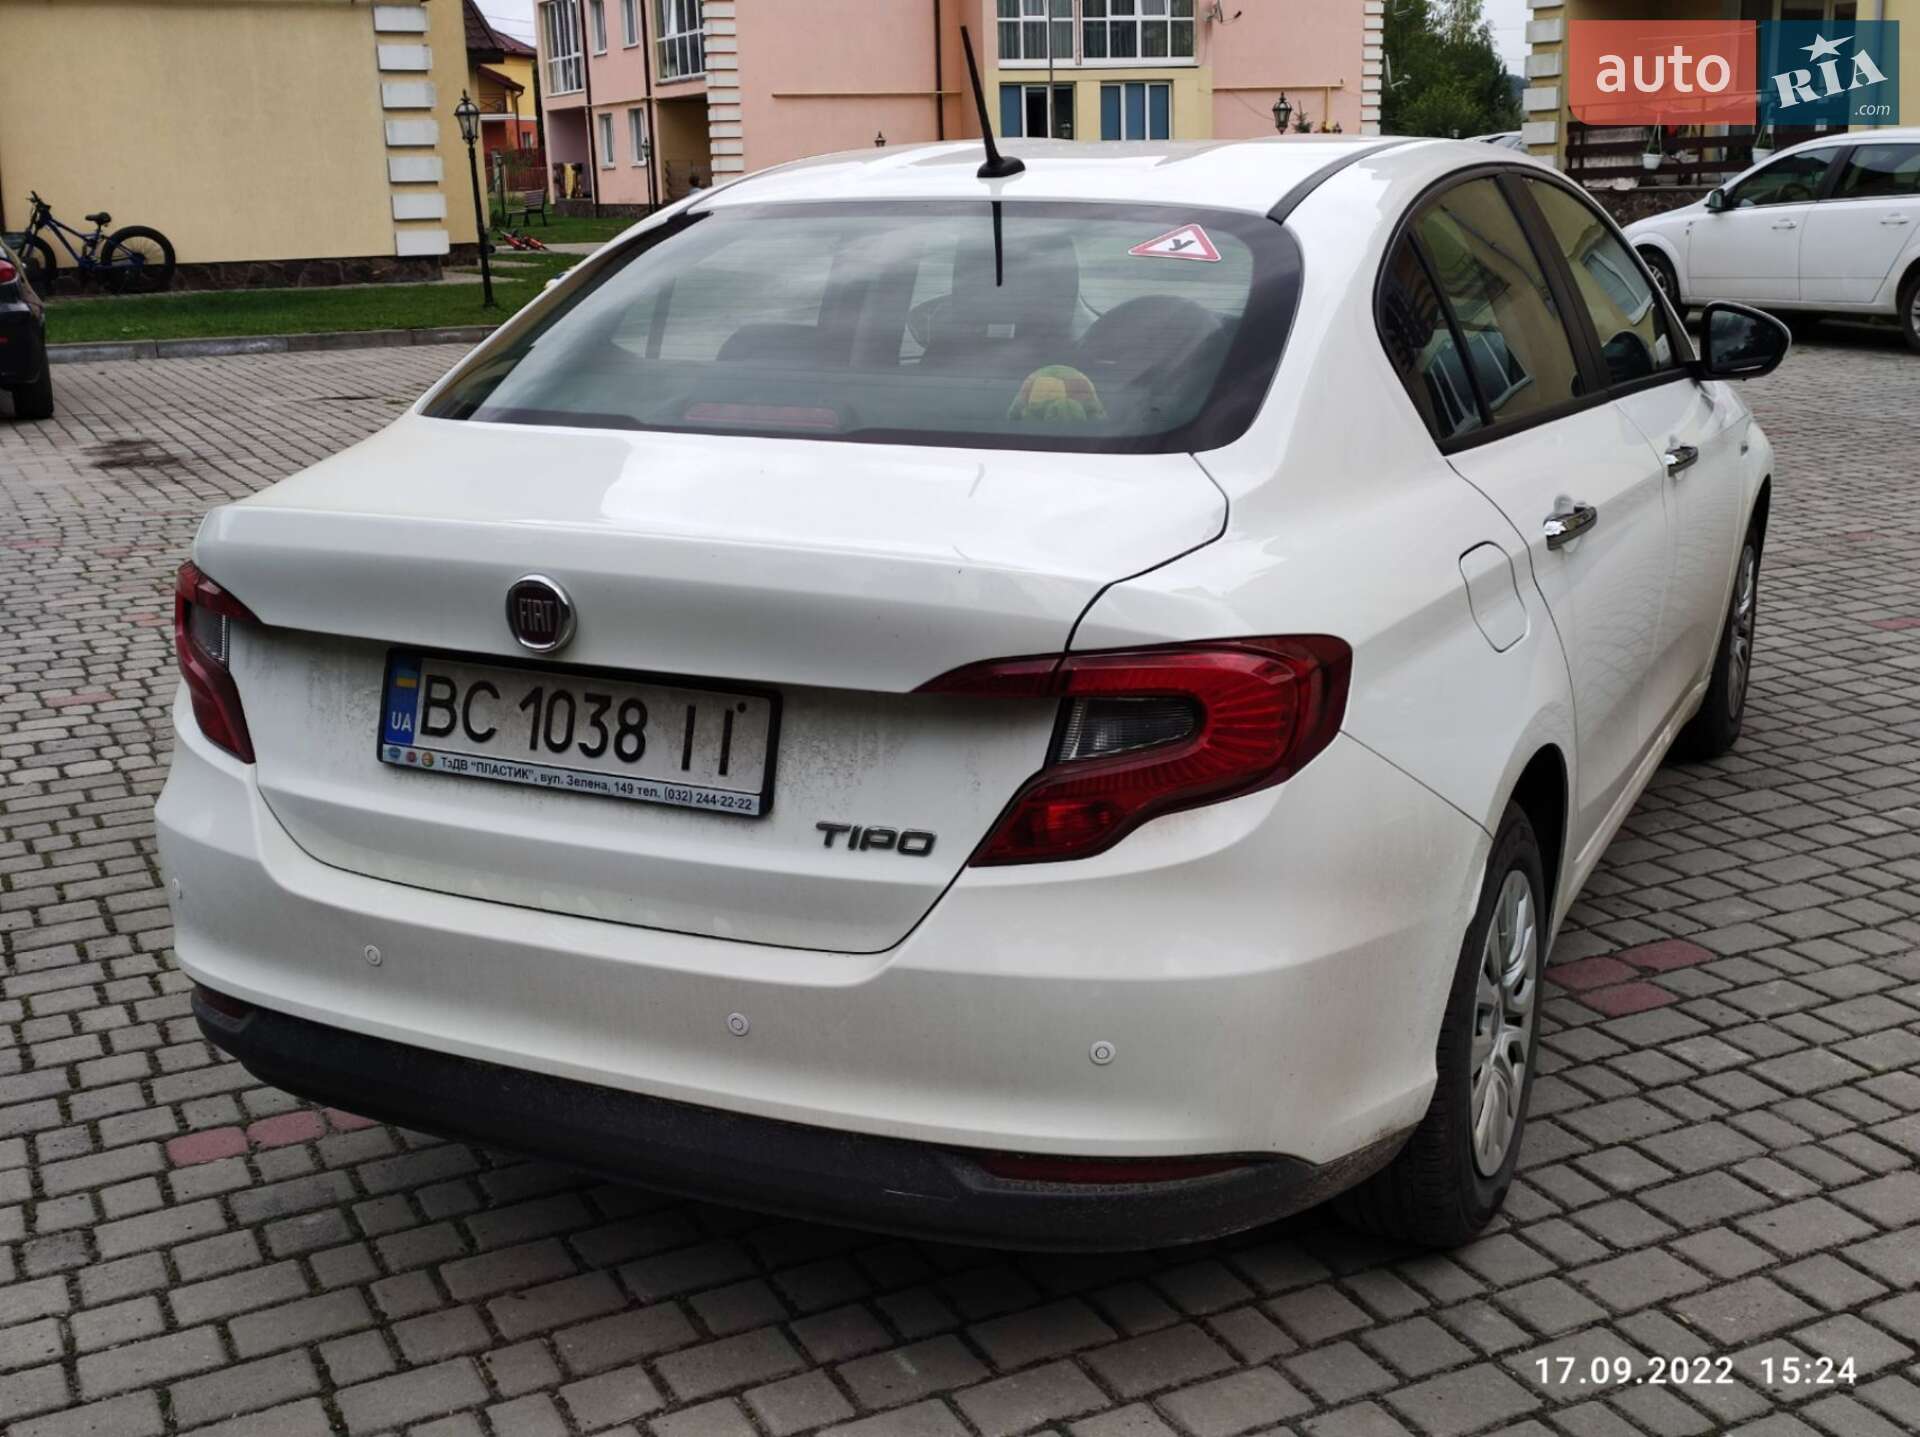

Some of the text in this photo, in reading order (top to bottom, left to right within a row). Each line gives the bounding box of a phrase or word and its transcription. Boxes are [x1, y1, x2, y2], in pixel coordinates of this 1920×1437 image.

[519, 598, 554, 632] FIAT
[391, 711, 412, 733] UA
[420, 674, 501, 743] BC
[519, 686, 648, 763] 1038
[540, 774, 563, 786] вул.
[566, 775, 611, 793] Зелена,
[614, 781, 634, 794] 149
[637, 788, 660, 799] тел.
[664, 786, 693, 802] (032)
[816, 821, 937, 857] TIPO
